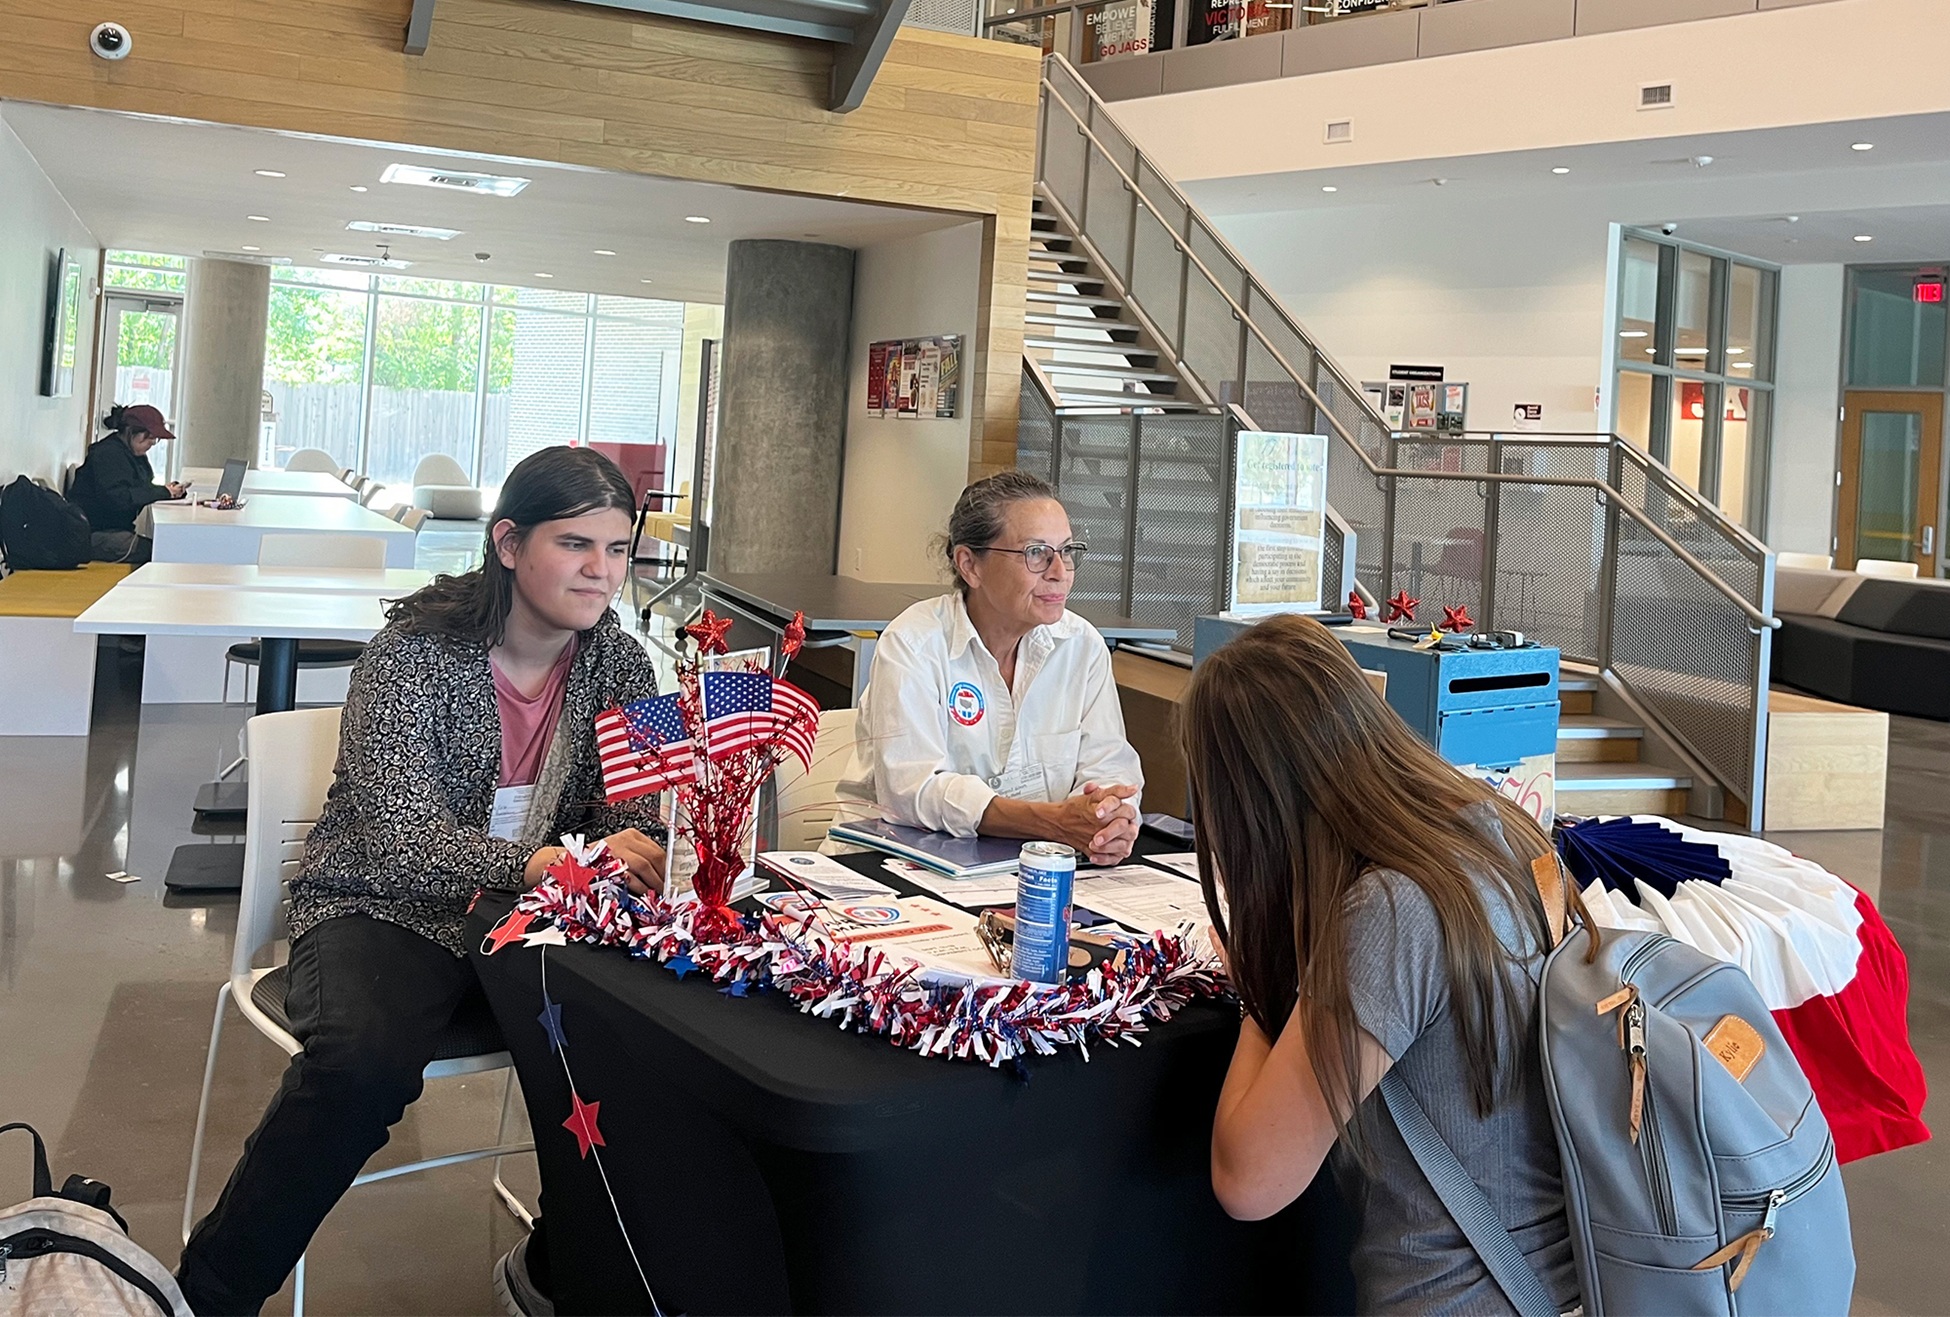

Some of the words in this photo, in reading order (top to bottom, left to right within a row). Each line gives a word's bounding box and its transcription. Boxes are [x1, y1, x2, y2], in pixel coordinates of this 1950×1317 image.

[1086, 6, 1136, 25] EMPOWE
[1095, 18, 1134, 34] BELIEVE
[1098, 29, 1135, 45] AMBITIO
[1100, 44, 1116, 57] GO
[1118, 38, 1147, 54] JAGS
[1718, 1042, 1740, 1063] Kylie
